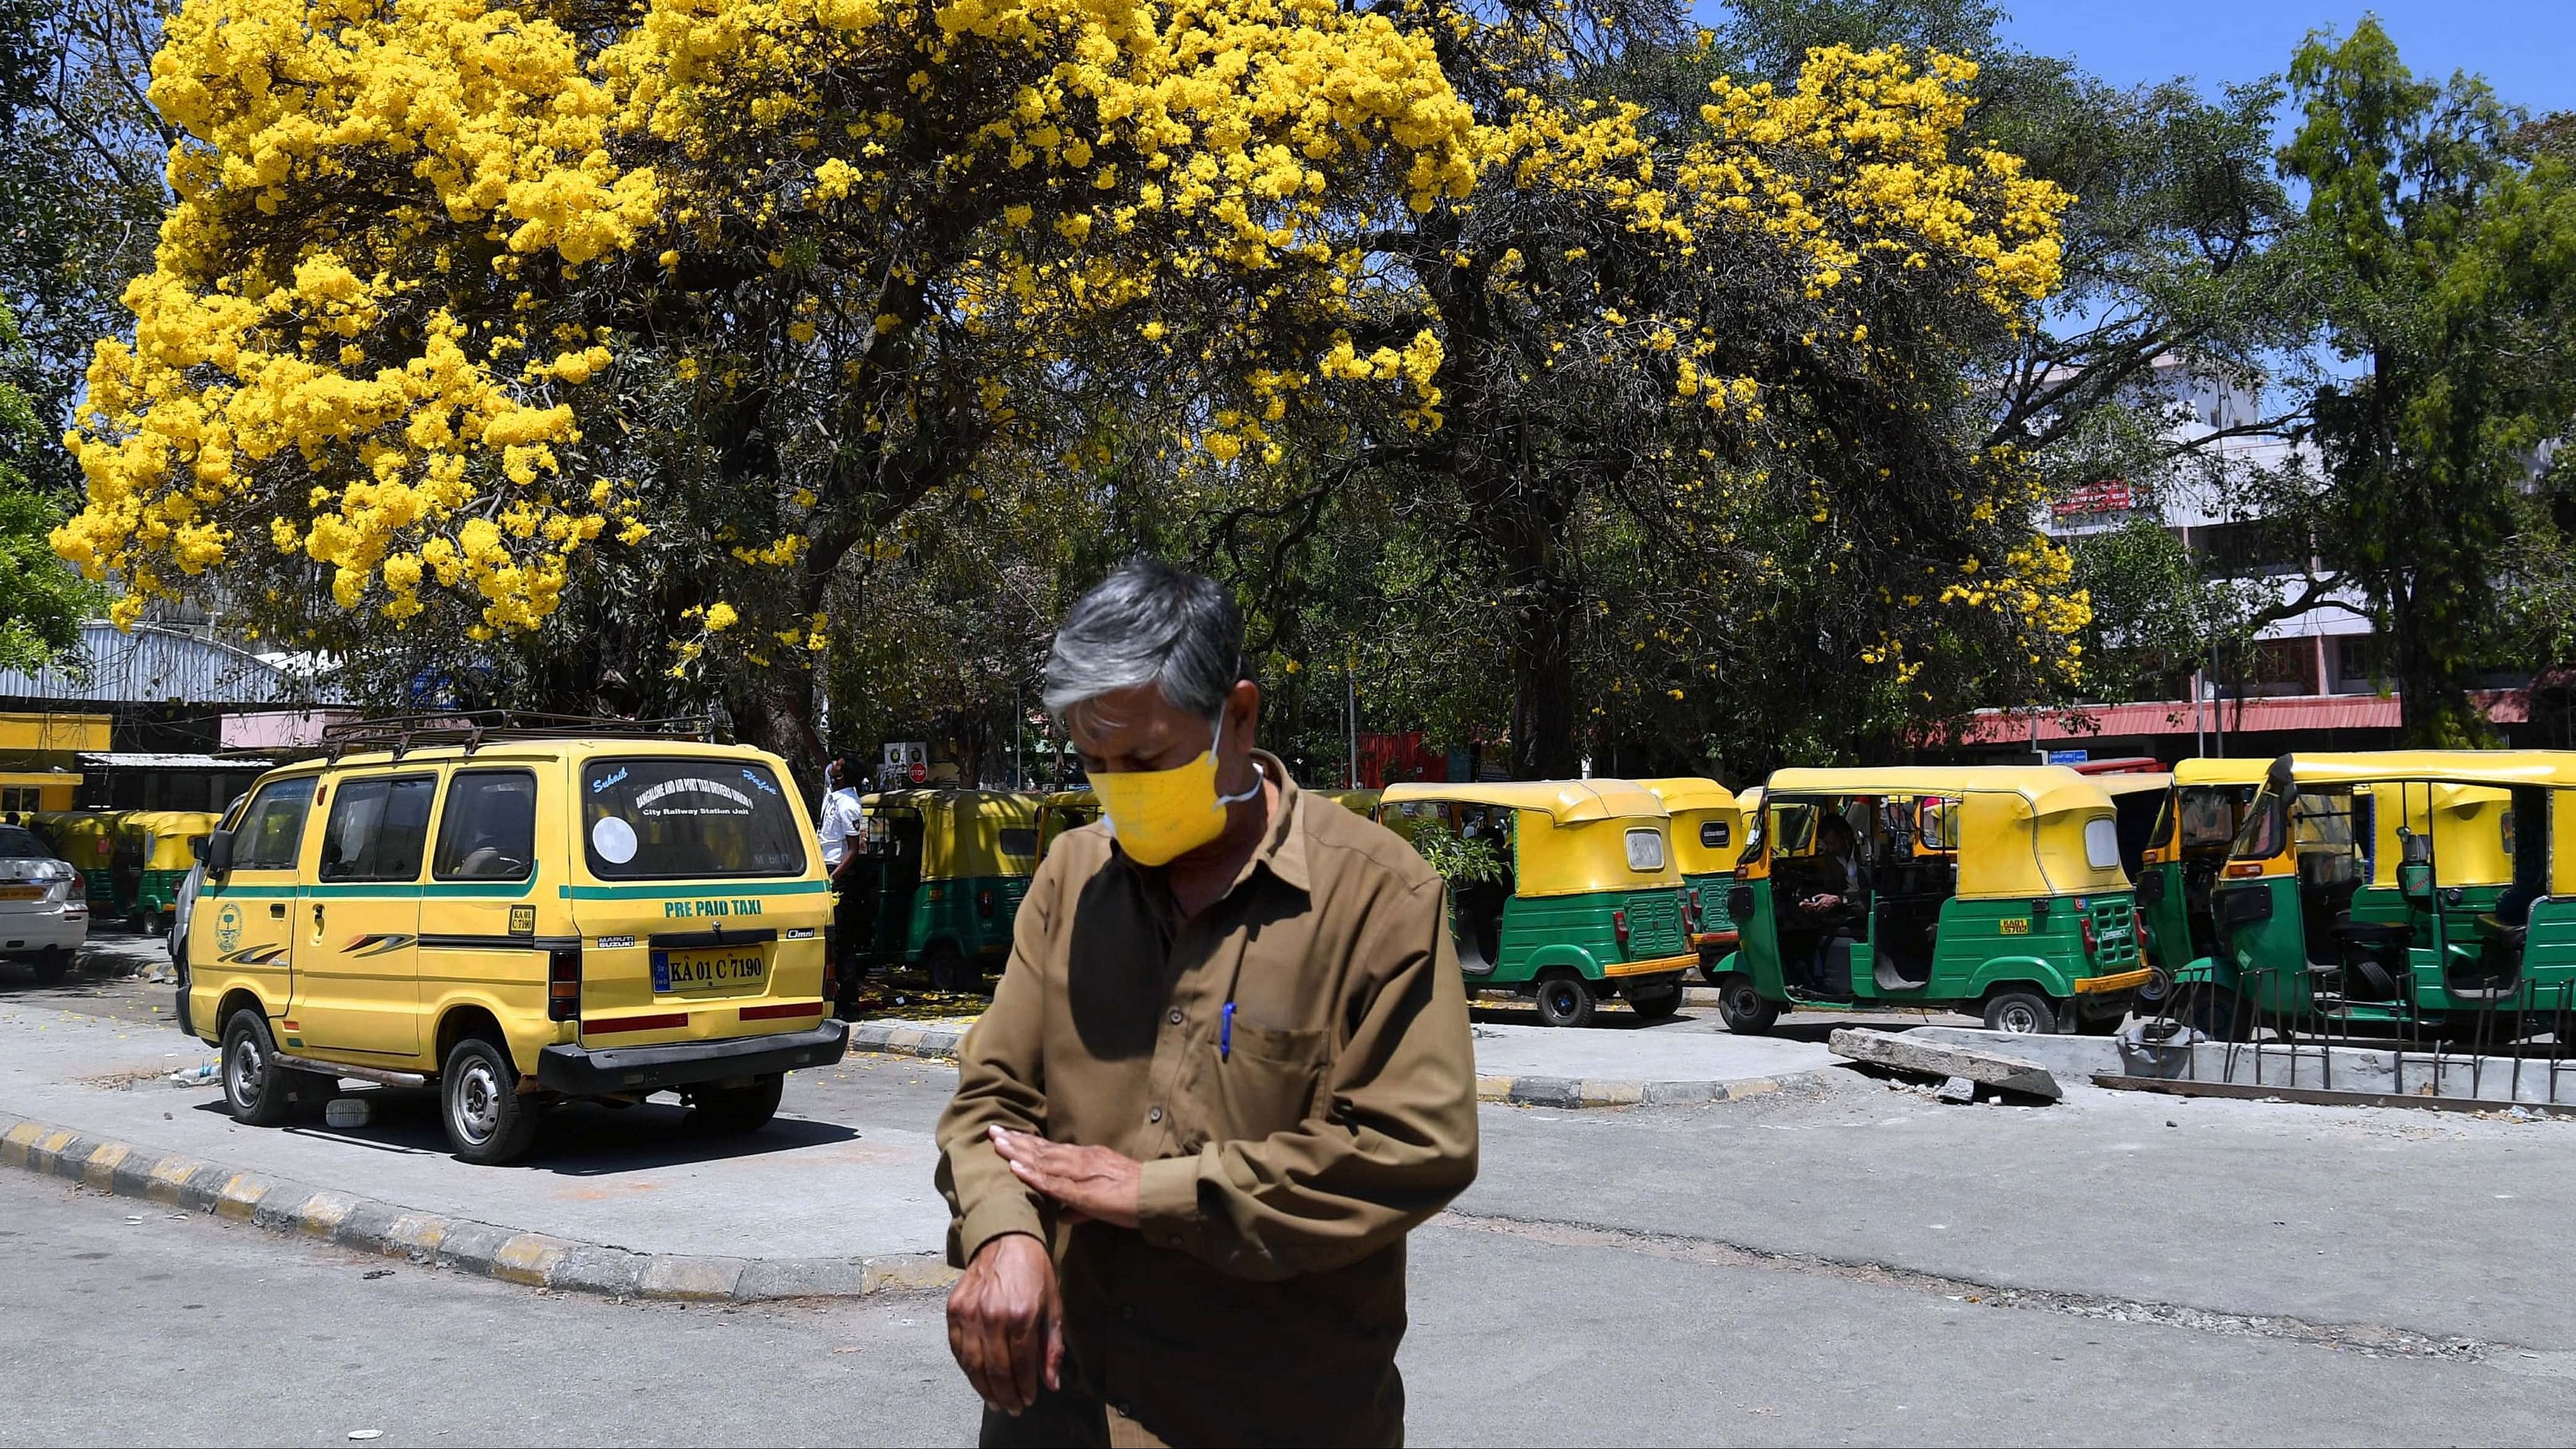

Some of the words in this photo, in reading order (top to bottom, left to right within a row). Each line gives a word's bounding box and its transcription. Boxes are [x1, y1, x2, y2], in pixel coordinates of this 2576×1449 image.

[636, 783, 665, 809] BANGALORE
[664, 780, 675, 795] AND
[675, 779, 685, 793] AIR
[683, 778, 698, 791] PORT
[697, 779, 710, 793] TAXI
[709, 781, 732, 799] DRIVERS
[664, 901, 693, 918] PRE
[695, 900, 729, 916] PAID
[731, 899, 762, 915] TAXI
[788, 929, 813, 938] Omni
[669, 961, 693, 982] KA
[696, 961, 712, 980] 01
[716, 960, 727, 978] C
[731, 957, 761, 978] 7190
